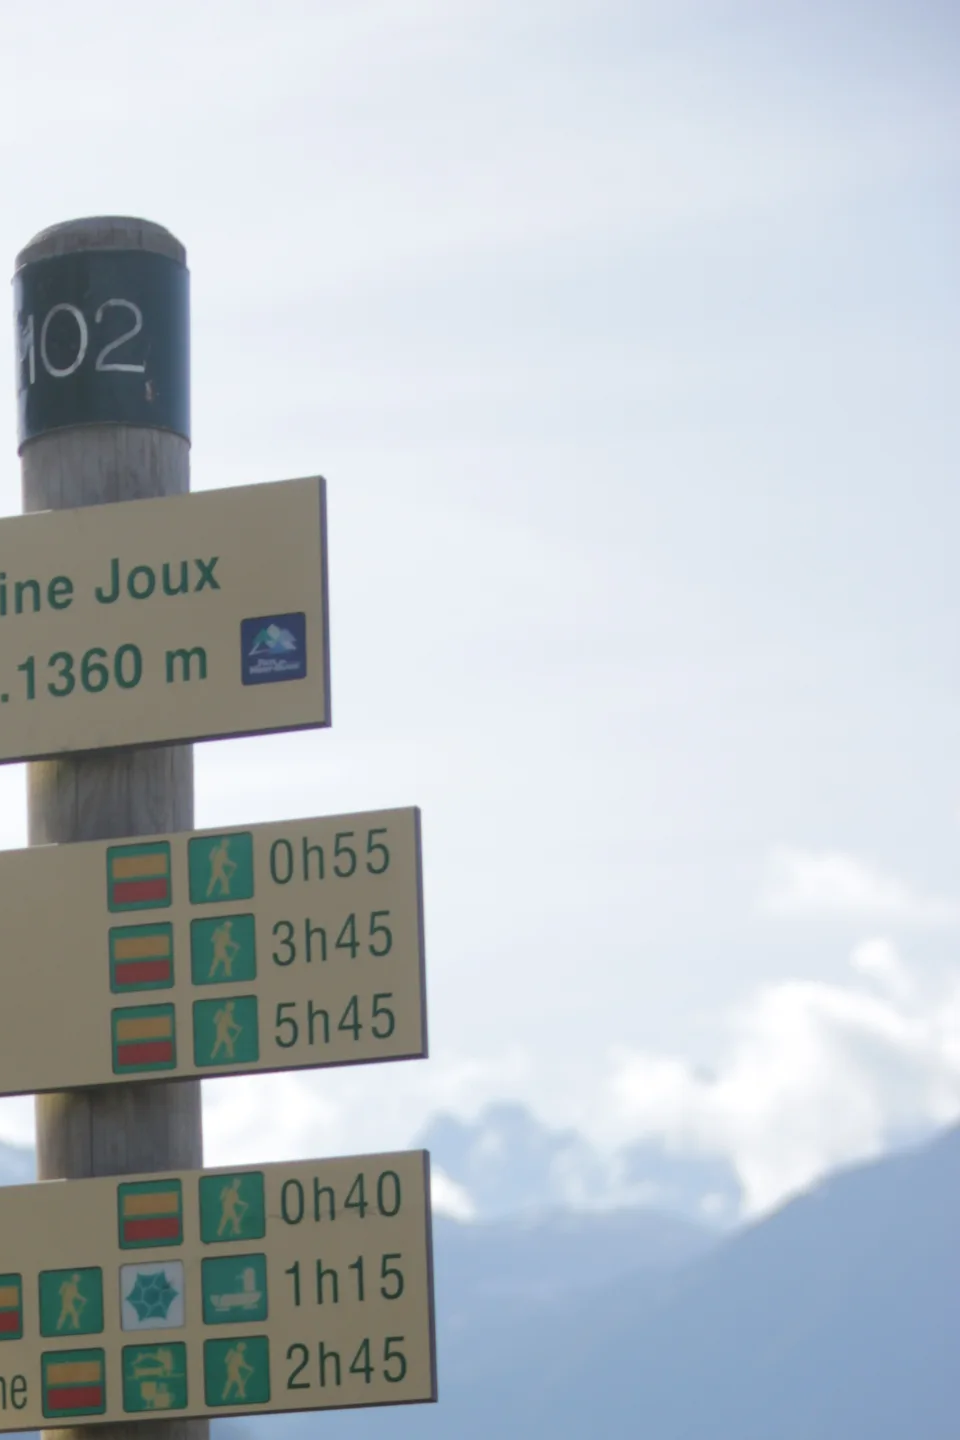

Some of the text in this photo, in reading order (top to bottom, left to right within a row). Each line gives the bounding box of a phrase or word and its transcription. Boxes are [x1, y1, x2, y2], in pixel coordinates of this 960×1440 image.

[96, 557, 220, 604] Joux
[166, 647, 206, 682] m
[270, 828, 389, 884] 0h55
[273, 911, 392, 966] 3h45
[276, 993, 394, 1048] 5h45
[281, 1171, 400, 1225] 0h40
[286, 1254, 403, 1306] 1h15
[287, 1336, 406, 1389] 2h45
